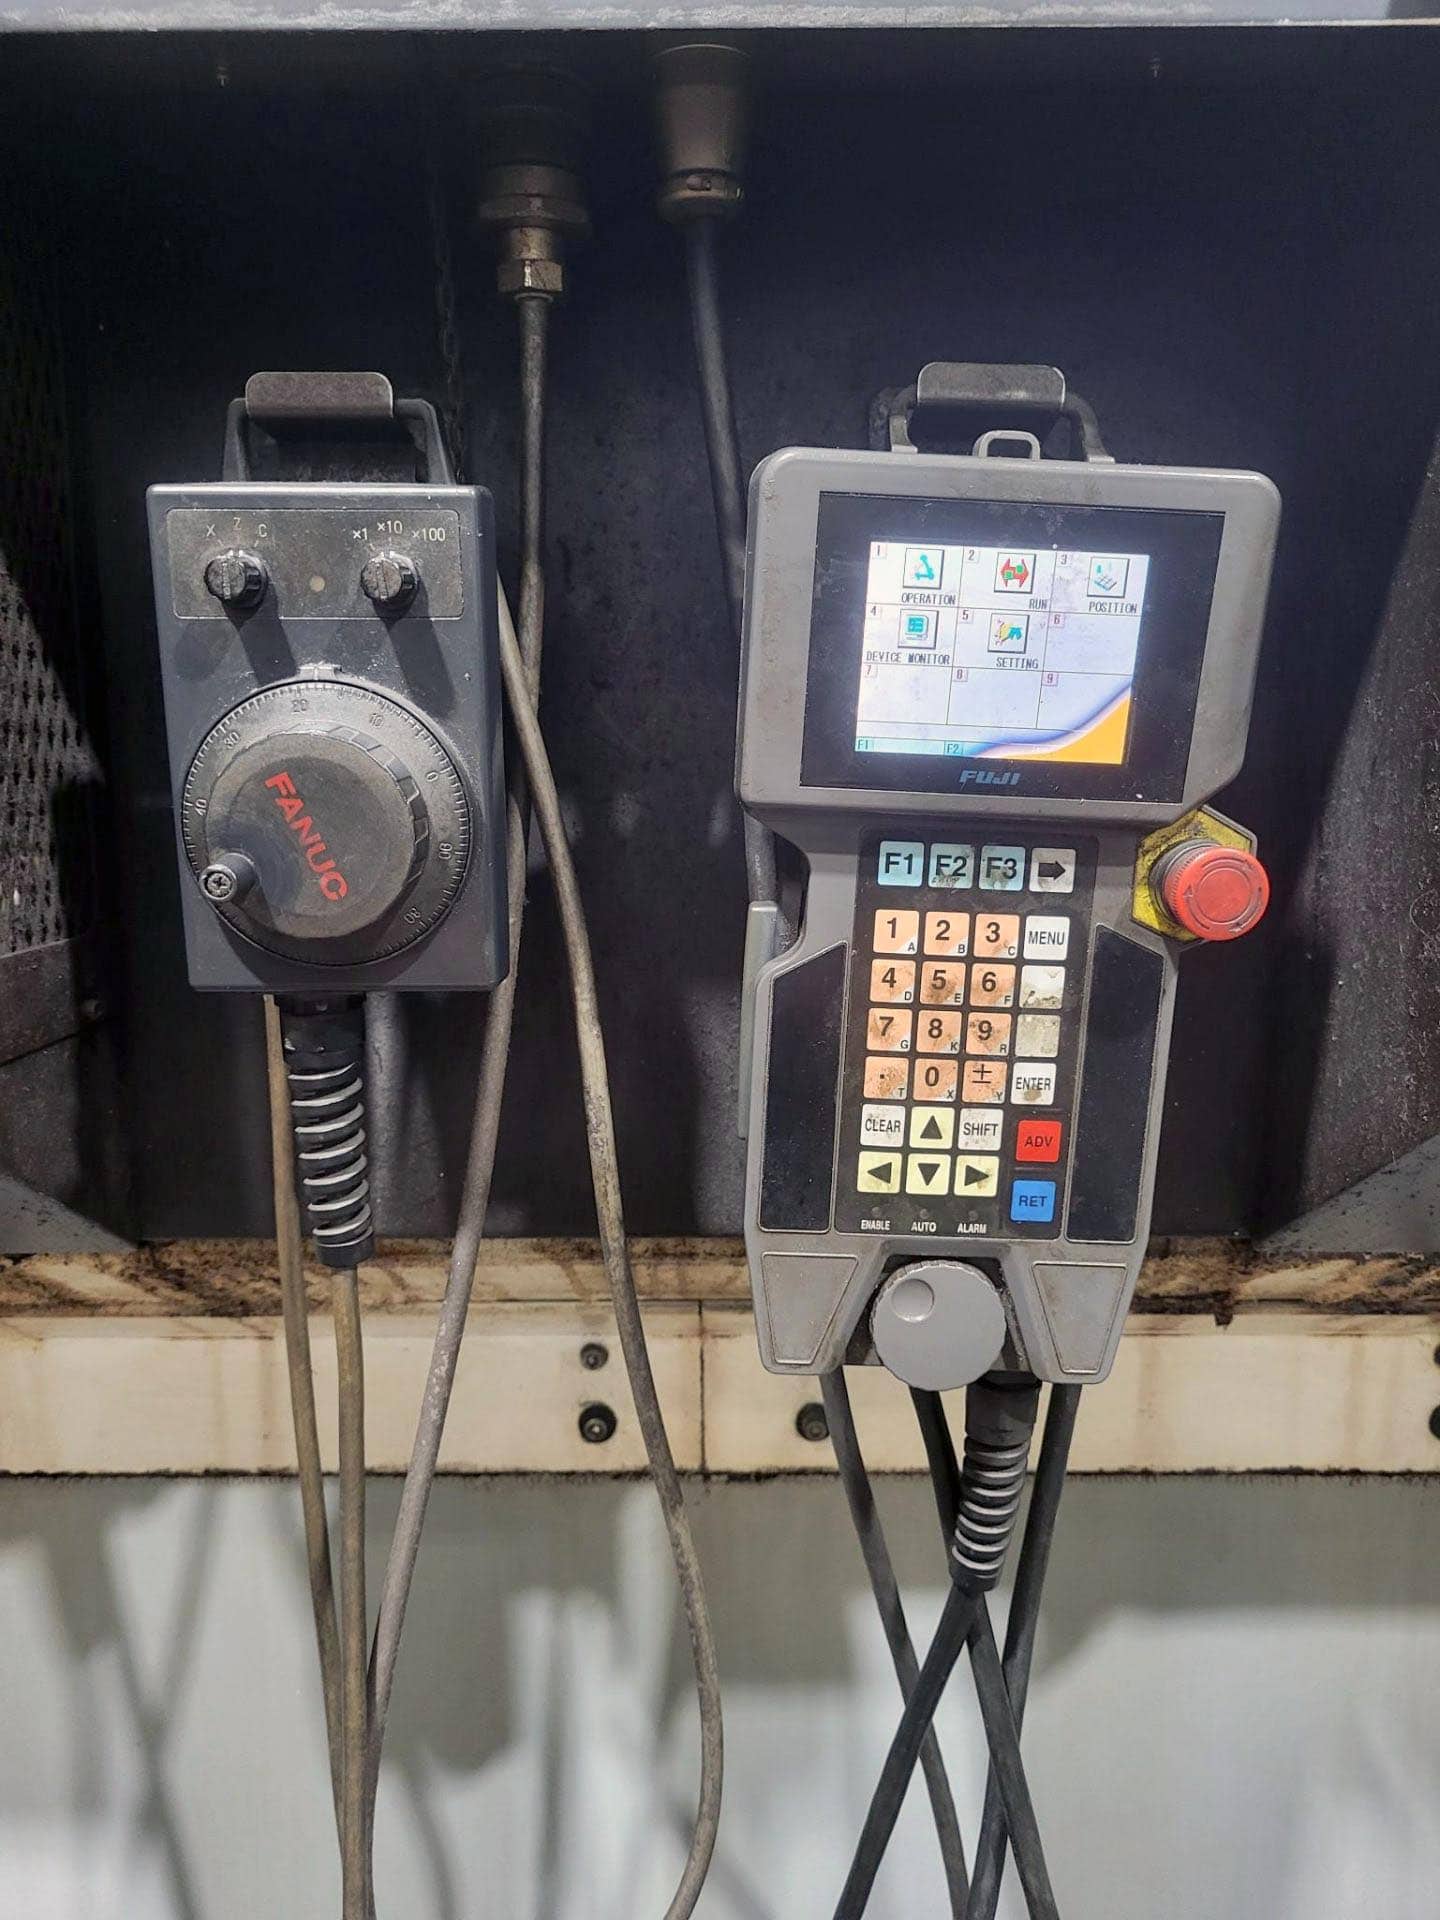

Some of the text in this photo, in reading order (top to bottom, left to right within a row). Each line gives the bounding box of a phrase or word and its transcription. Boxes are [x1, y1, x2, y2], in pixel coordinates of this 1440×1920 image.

[233, 517, 242, 530] Z
[206, 523, 216, 537] X
[258, 525, 268, 538] C
[968, 550, 975, 560] 2
[1061, 554, 1067, 564] 3
[901, 592, 956, 606] OPERATION
[1029, 599, 1047, 609] RUN
[870, 605, 877, 616] 4
[1088, 601, 1137, 614] POSITION
[962, 609, 969, 620] 5
[1054, 614, 1060, 624] 6
[866, 650, 950, 664] DEVICE MONITOR
[996, 657, 1039, 669] SETTING
[956, 669, 963, 679] 8
[1046, 674, 1053, 684] 9
[857, 740, 869, 750] F1
[947, 744, 959, 755] F2
[959, 770, 1021, 786] FUJI
[264, 772, 348, 901] FANUC
[884, 852, 913, 875] F1
[935, 854, 967, 877] F2
[985, 856, 1017, 880] F3
[887, 917, 897, 938] 1
[935, 920, 950, 941] 2
[985, 922, 1000, 943] 3
[1028, 931, 1065, 946] MENU
[907, 944, 915, 952] A
[958, 945, 965, 954] B
[1008, 946, 1015, 956] C
[881, 967, 897, 988] 4
[931, 969, 946, 990] 5
[981, 971, 997, 992] 6
[904, 991, 912, 1000] D
[954, 993, 961, 1003] E
[1004, 995, 1011, 1005] F
[879, 1016, 894, 1037] 7
[928, 1018, 943, 1039] 8
[978, 1020, 993, 1041] 9
[900, 1040, 908, 1050] G
[950, 1042, 958, 1051] K
[1000, 1044, 1007, 1053] R
[925, 1066, 939, 1087] 0
[1016, 1077, 1051, 1091] ENTER
[898, 1087, 905, 1097] T
[946, 1090, 954, 1099] X
[995, 1091, 1003, 1100] Y
[865, 1118, 901, 1133] CLEAR
[963, 1122, 999, 1137] SHIFT
[1024, 1136, 1054, 1148] ADV
[1018, 1195, 1047, 1207] RET
[860, 1219, 891, 1231] ENABLE
[911, 1221, 937, 1232] AUTO
[957, 1222, 987, 1234] ALARM
